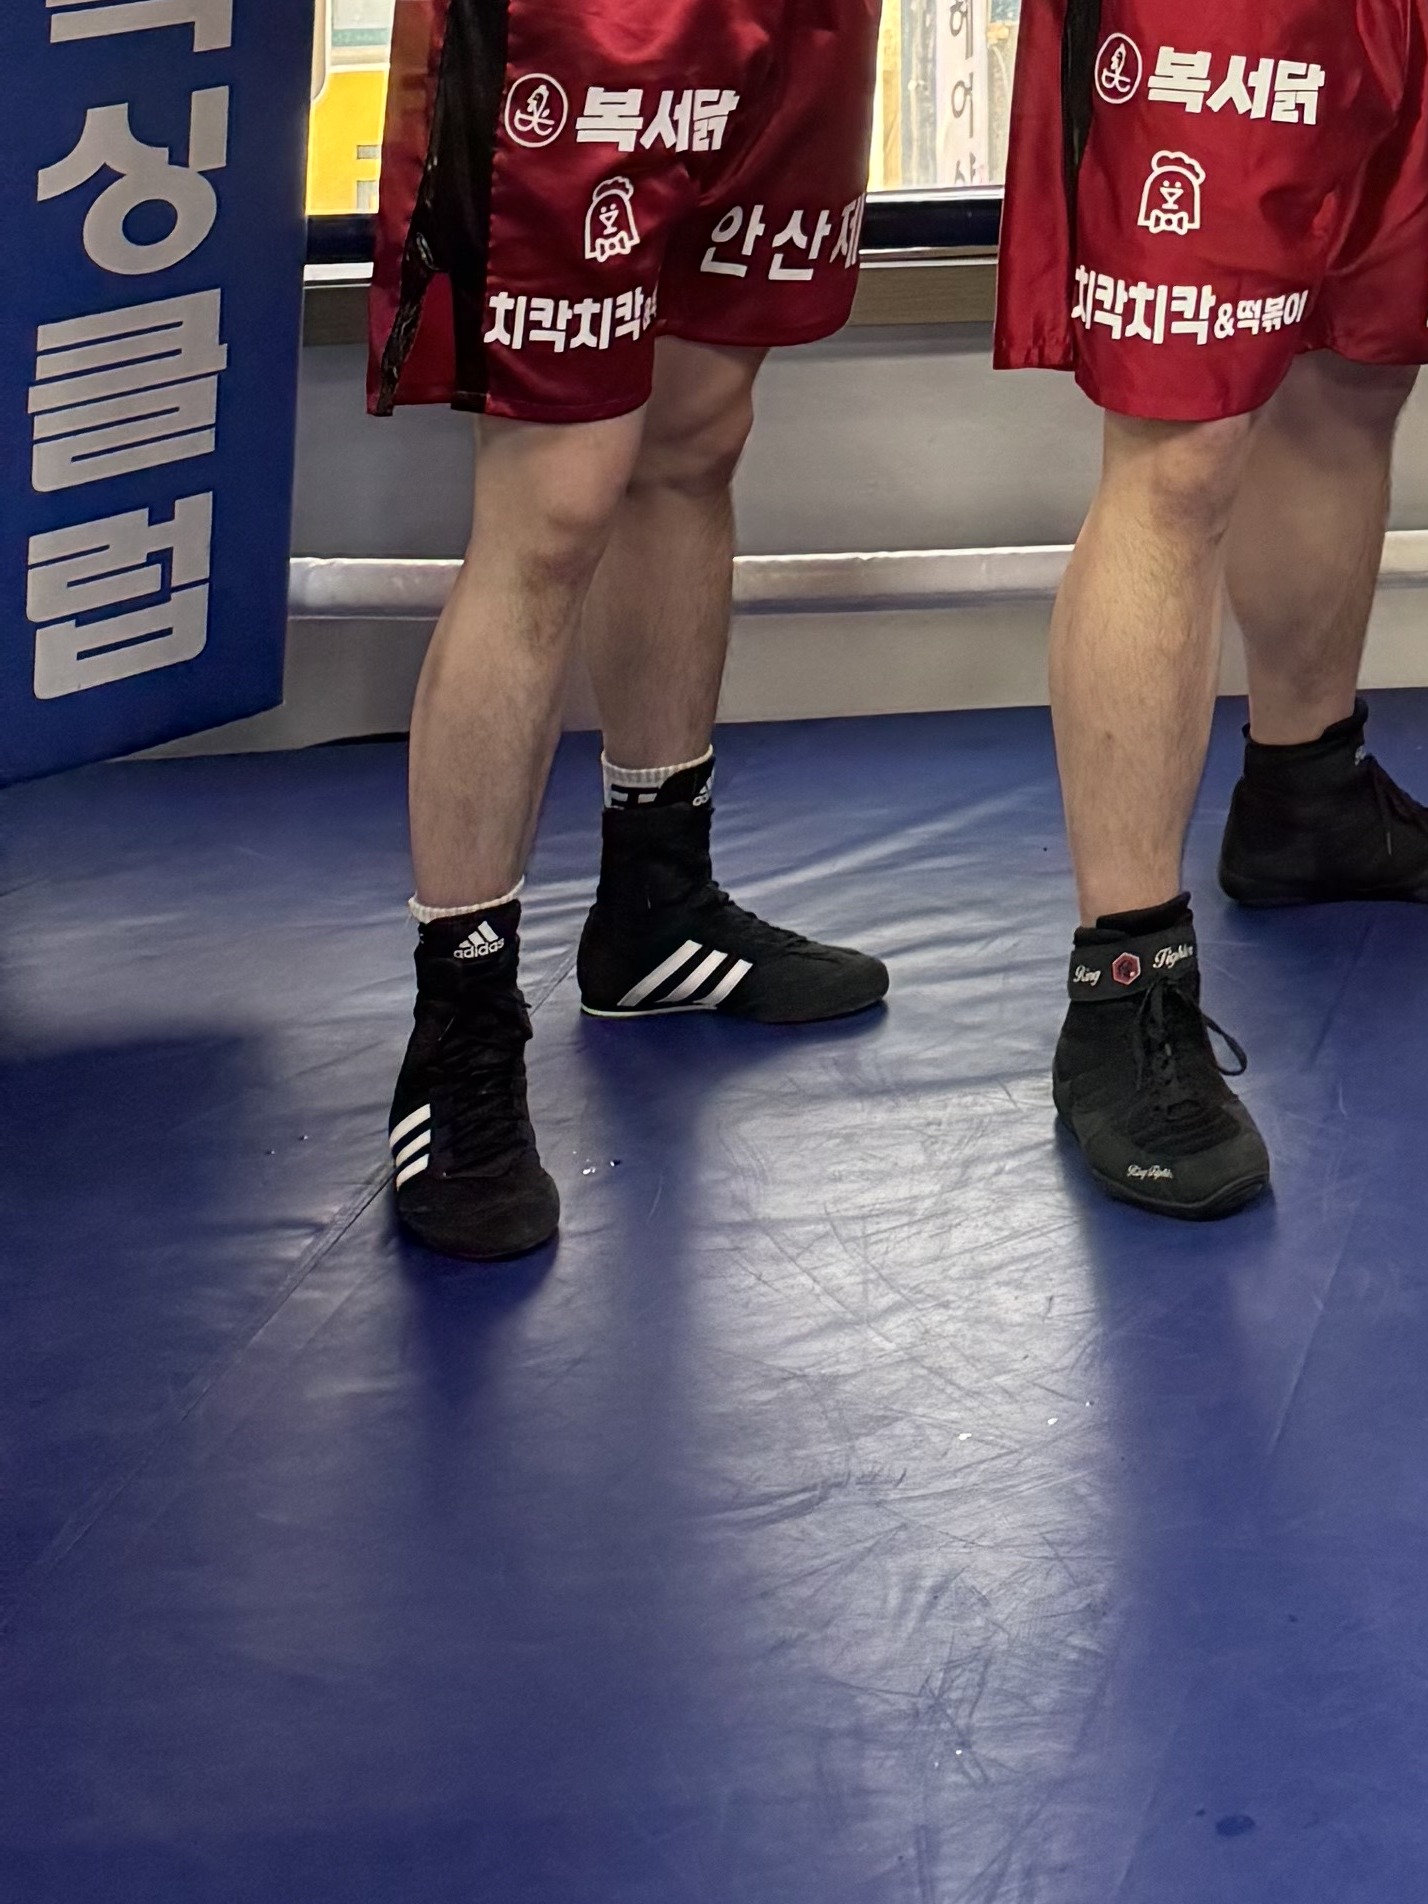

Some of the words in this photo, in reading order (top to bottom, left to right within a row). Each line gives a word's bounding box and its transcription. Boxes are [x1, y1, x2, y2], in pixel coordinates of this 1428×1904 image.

[1147, 46, 1326, 125] 복서닭
[575, 86, 740, 153] 복서닭
[453, 937, 505, 960] adidas
